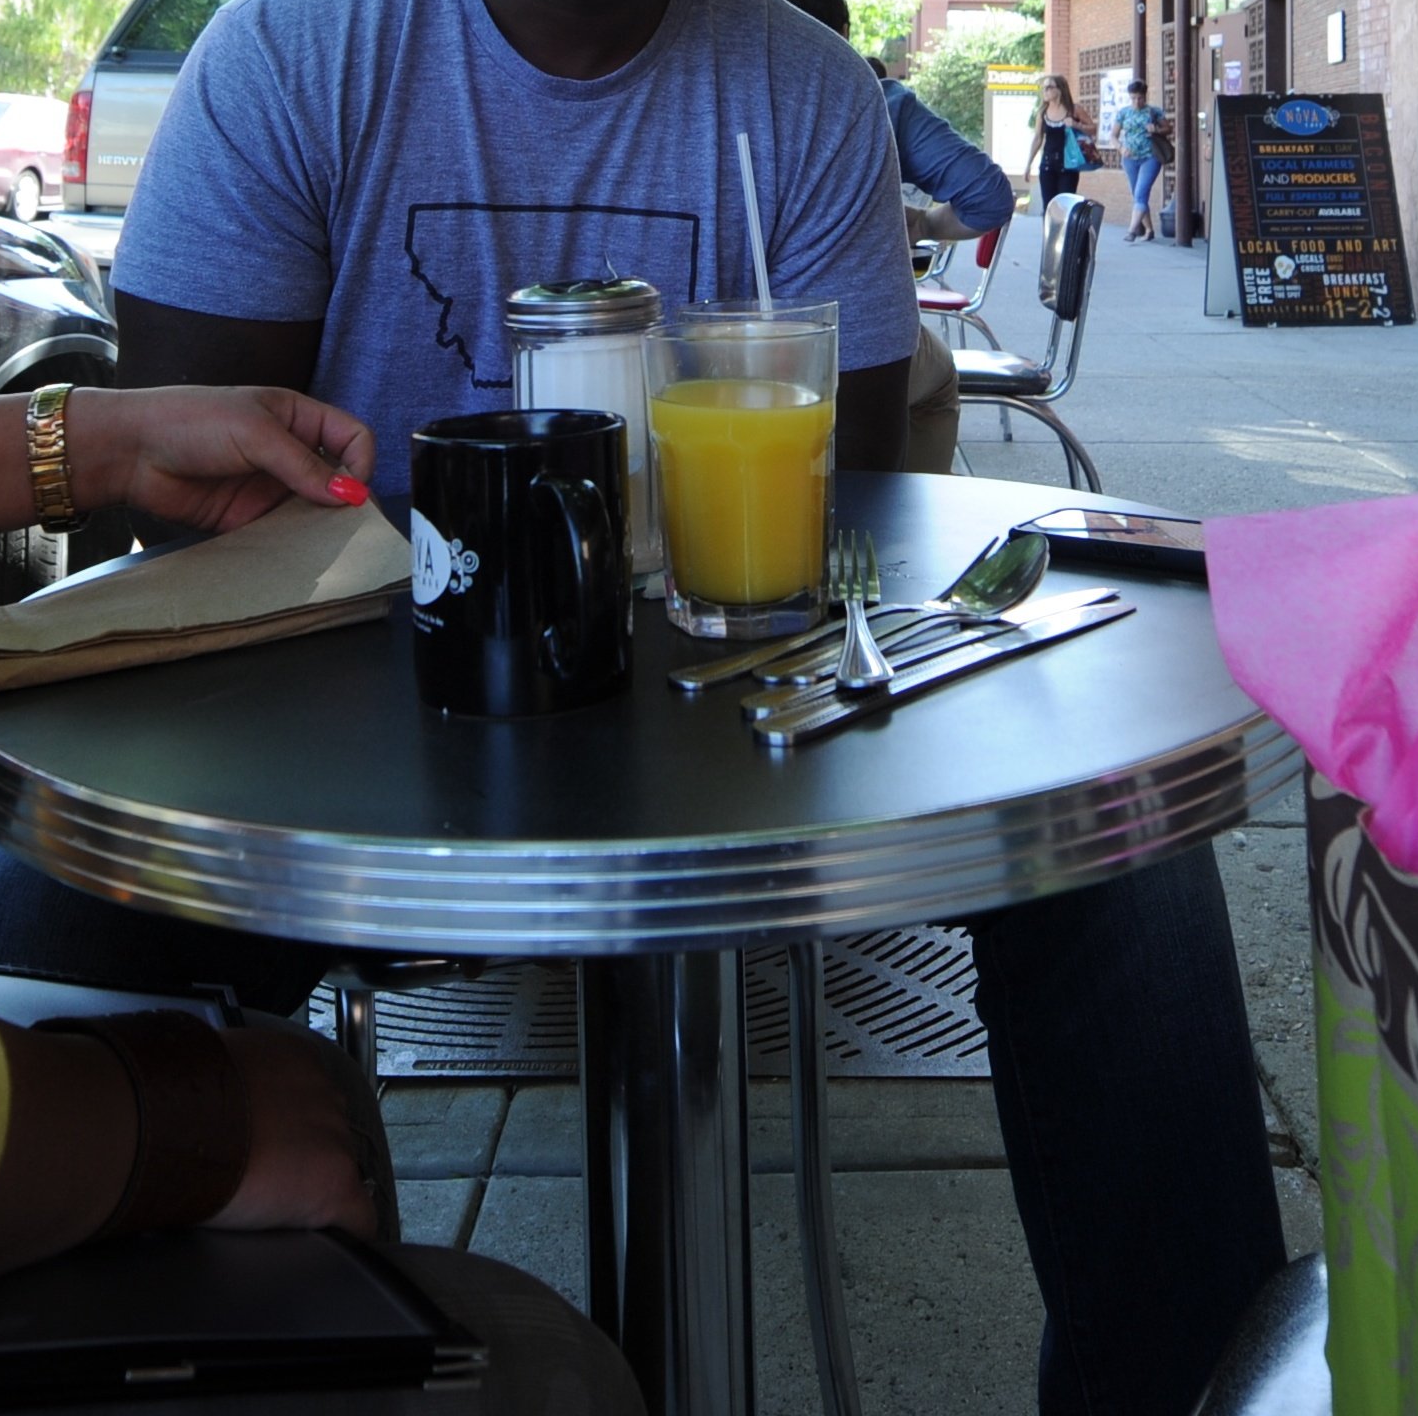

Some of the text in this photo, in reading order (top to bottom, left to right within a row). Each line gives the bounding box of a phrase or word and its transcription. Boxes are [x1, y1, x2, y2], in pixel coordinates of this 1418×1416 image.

[1259, 144, 1315, 154] BREAKFAST
[1261, 159, 1355, 170] LOCAL FARMERS
[1263, 173, 1356, 184] AND PRODUCERS
[1266, 191, 1360, 201] FULL ESPRESSO BAR
[1267, 207, 1361, 217] CARRY-OUT AVAILABLE
[1238, 238, 1397, 253] LOCAL FOOD AND ART
[1295, 254, 1325, 264] LOCALS
[1323, 273, 1385, 285] BREAKFAST
[1242, 268, 1258, 304] GLUTEN
[1255, 268, 1273, 303] FREE
[1324, 286, 1370, 298] LUNCH
[1325, 298, 1372, 319] 11-2
